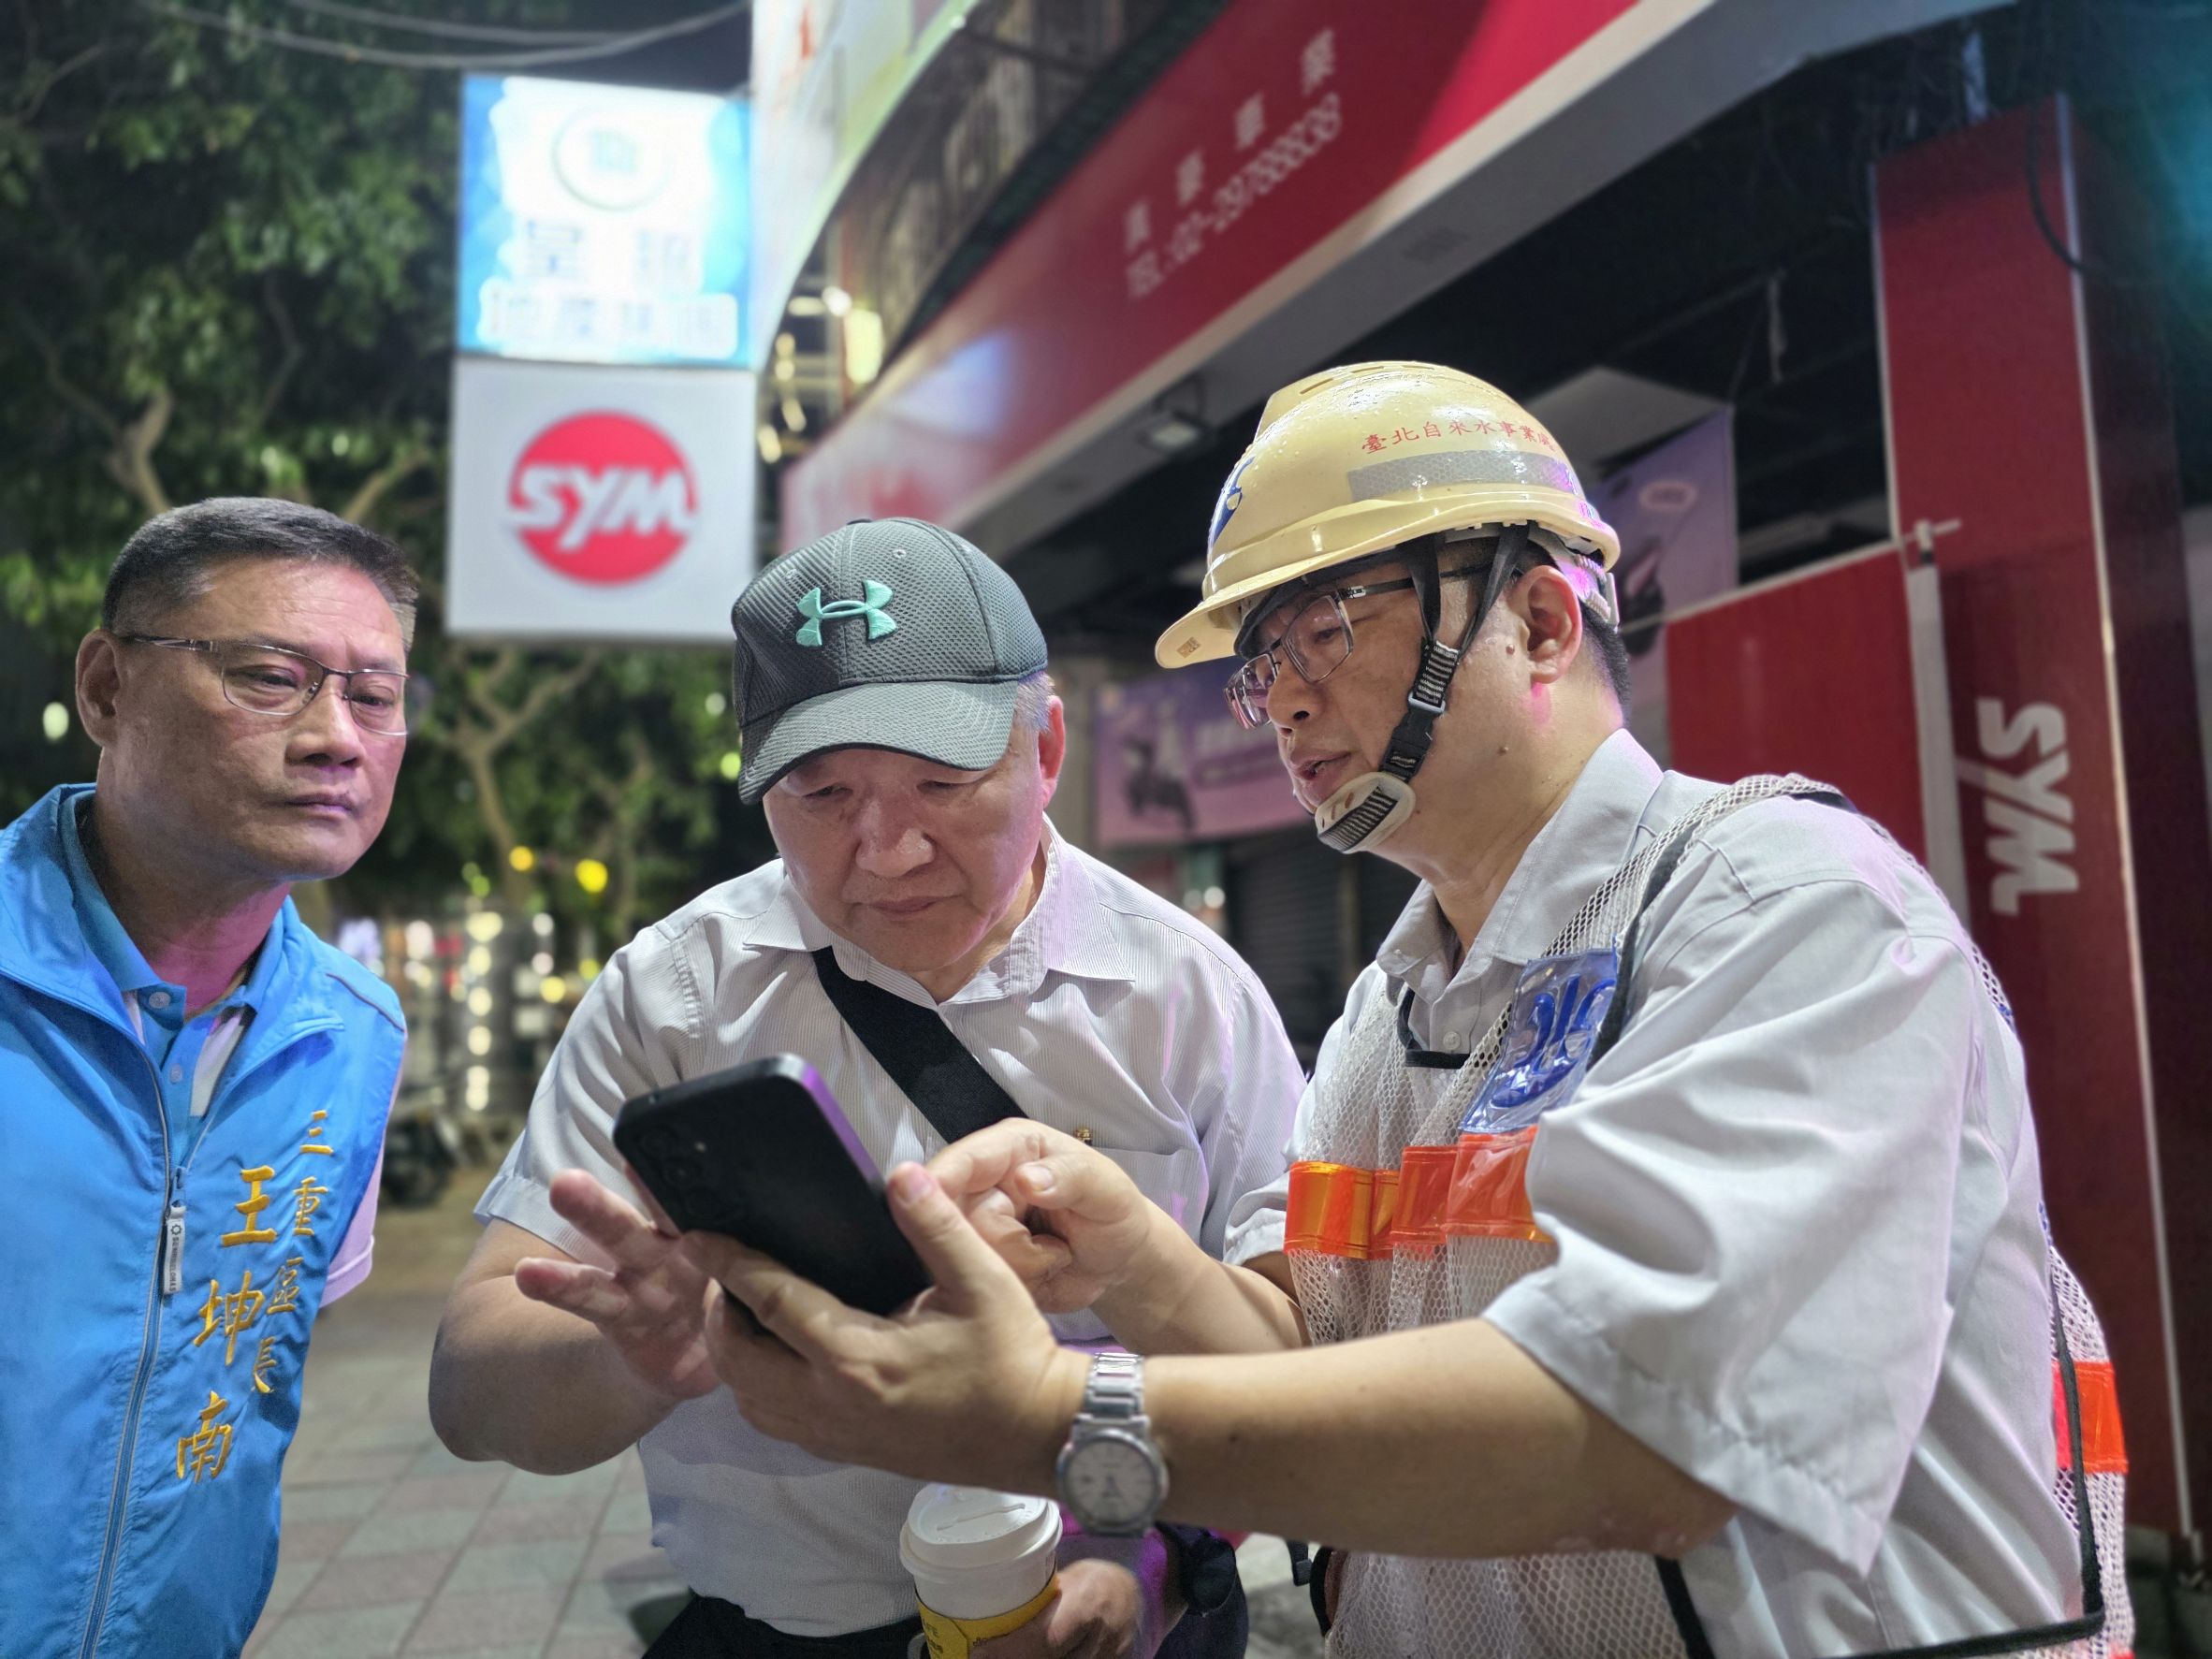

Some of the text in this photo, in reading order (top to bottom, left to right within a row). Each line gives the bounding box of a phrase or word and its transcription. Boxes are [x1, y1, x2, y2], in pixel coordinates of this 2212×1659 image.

[506, 462, 695, 554] SYM
[1957, 696, 2079, 917] SYM
[176, 1164, 278, 1485] 王坤南
[252, 1110, 334, 1394] 三重區長
